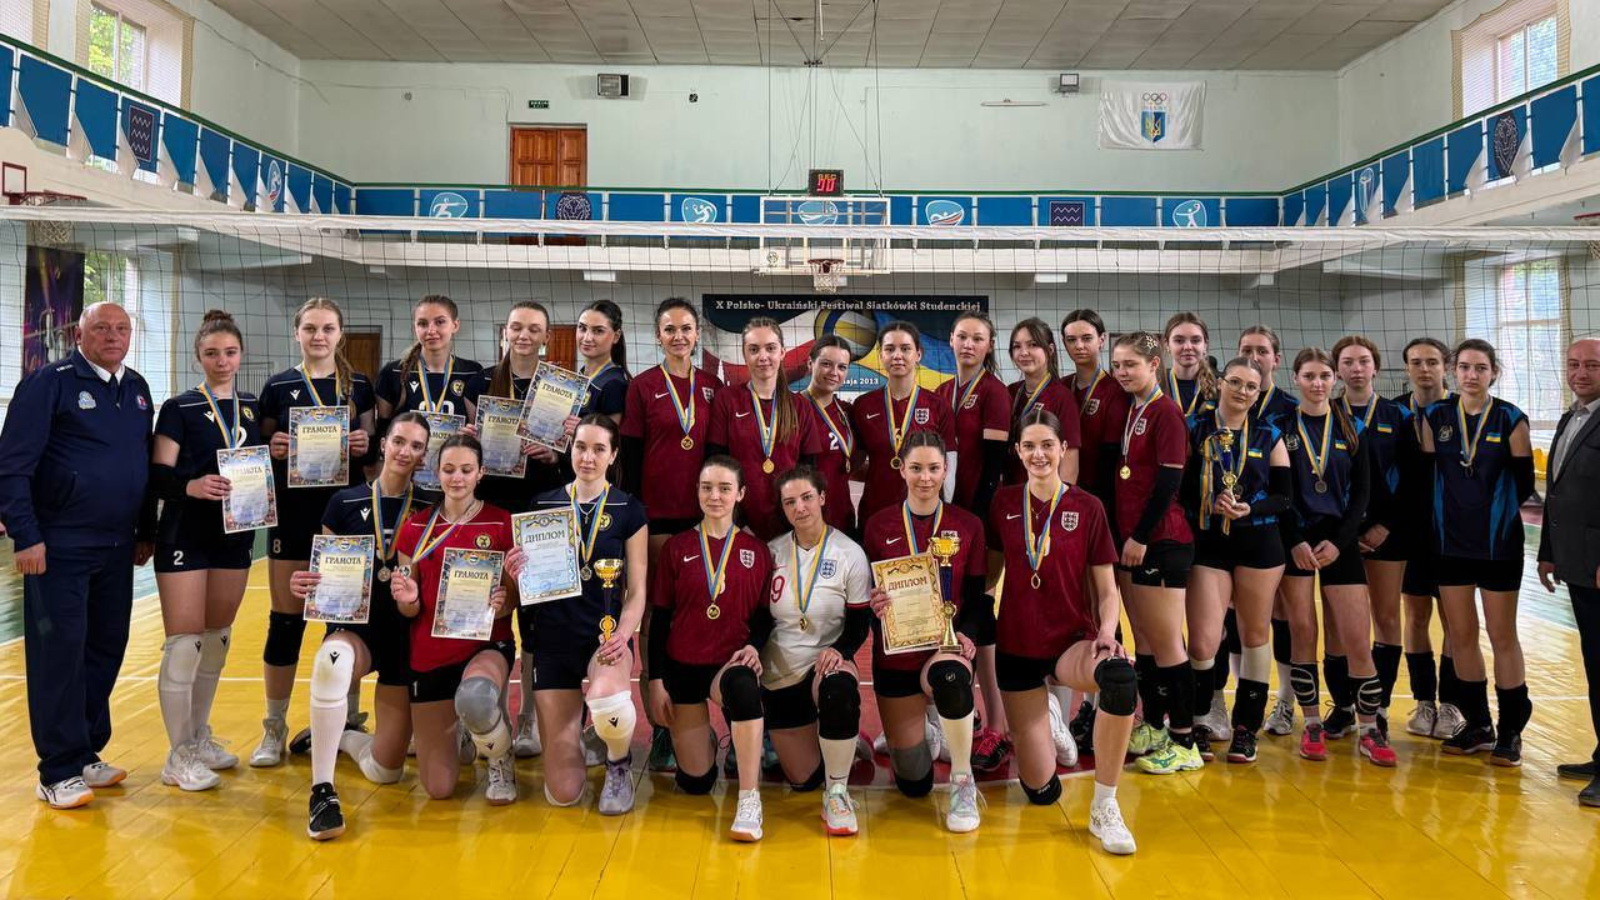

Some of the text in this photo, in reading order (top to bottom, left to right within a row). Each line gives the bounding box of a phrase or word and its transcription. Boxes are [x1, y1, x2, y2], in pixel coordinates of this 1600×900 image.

[715, 300, 725, 310] X
[820, 300, 864, 310] Festiwal
[866, 300, 918, 311] Siatkówki
[919, 301, 981, 313] Studenckiej
[859, 377, 880, 386] 2013
[302, 425, 338, 434] ГРАМОТА
[828, 431, 840, 451] 2
[524, 529, 566, 544] ДИПЛОМ
[272, 538, 282, 554] 8
[173, 550, 184, 566] 2
[324, 556, 362, 565] ГРАМОТА
[453, 570, 489, 580] ГРАМОТА
[888, 575, 928, 591] ДИПЛОМ
